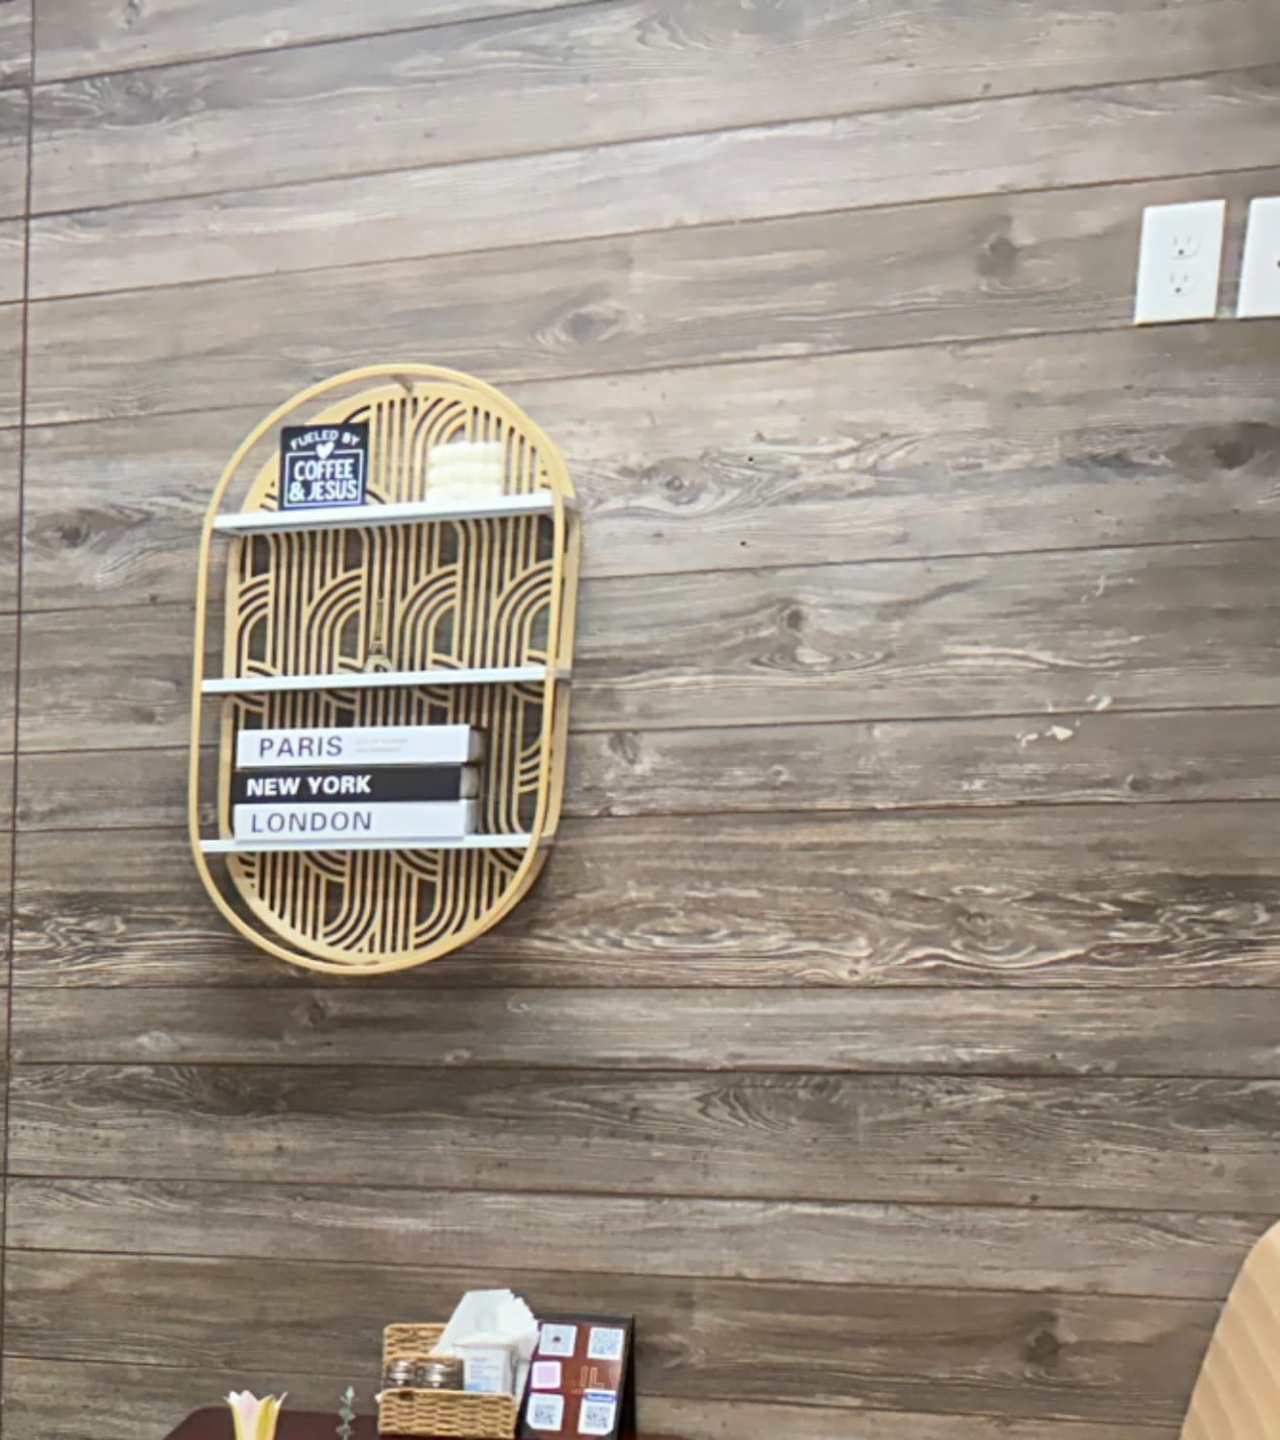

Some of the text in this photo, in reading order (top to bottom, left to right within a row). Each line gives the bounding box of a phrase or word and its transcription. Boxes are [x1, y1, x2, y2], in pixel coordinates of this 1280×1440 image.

[290, 429, 361, 450] FUELED BY
[293, 458, 355, 481] COFFEE
[289, 480, 357, 502] & JESUS
[259, 736, 343, 758] PARIS
[246, 775, 372, 797] NEW YORK
[251, 811, 372, 833] LONDON
